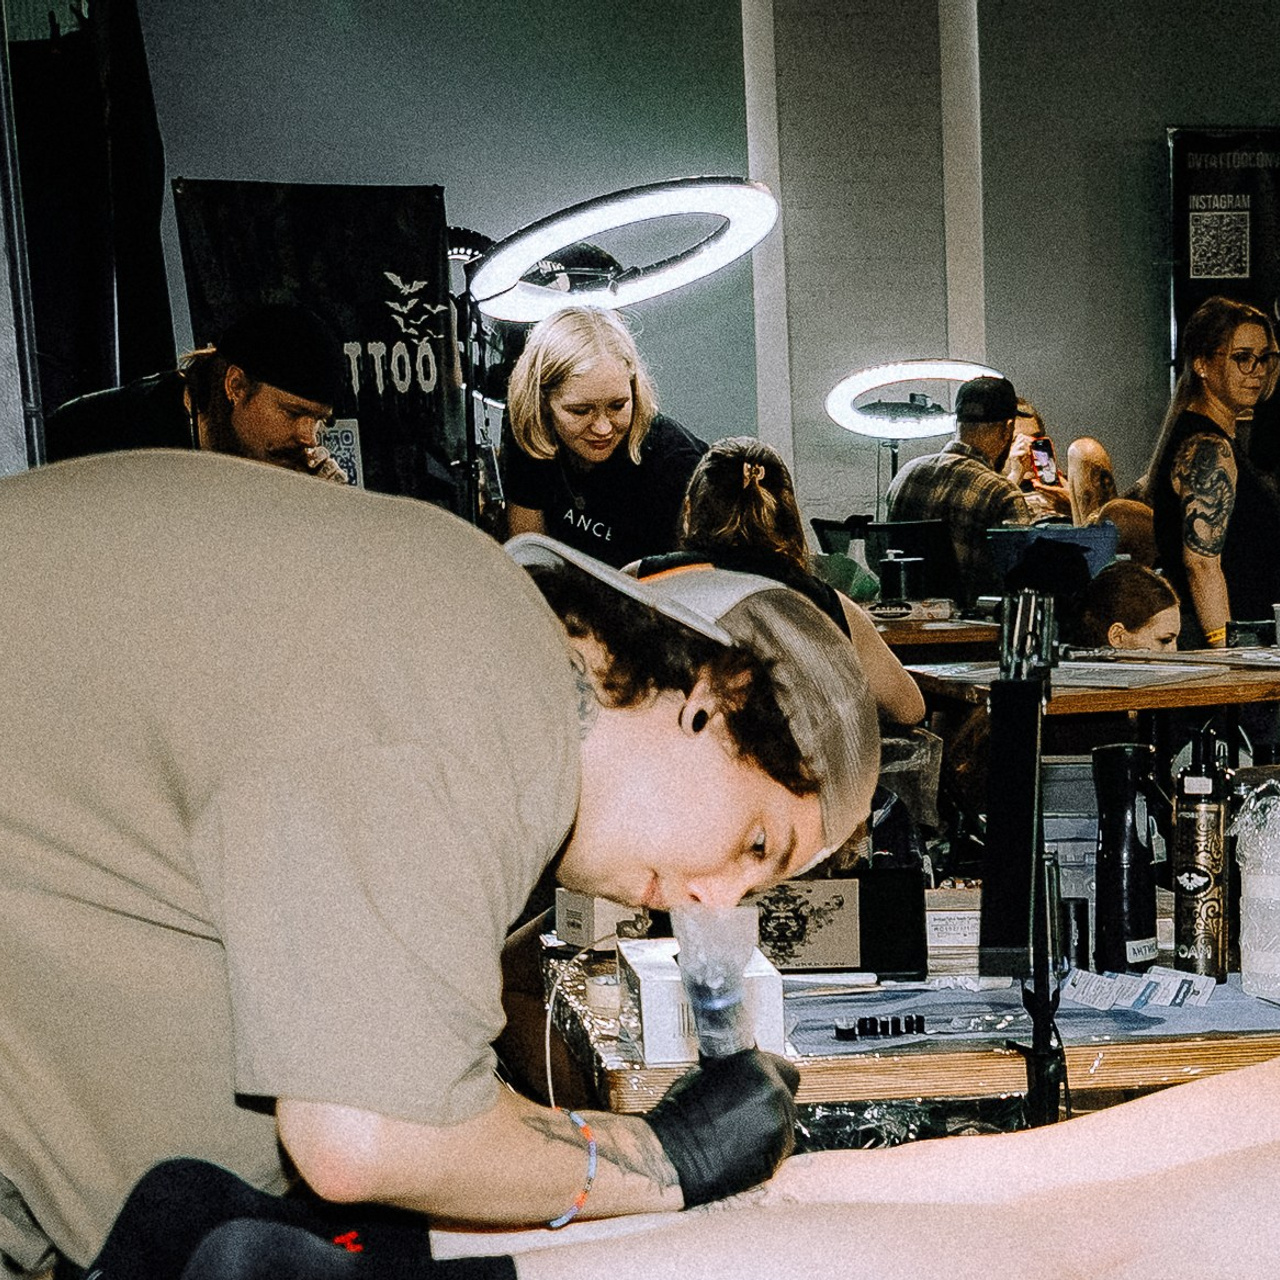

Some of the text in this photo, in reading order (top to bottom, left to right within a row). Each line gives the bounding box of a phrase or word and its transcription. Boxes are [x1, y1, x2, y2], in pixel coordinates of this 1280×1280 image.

[1189, 195, 1250, 209] INSTAGRAM
[344, 341, 437, 396] TTOO
[1178, 944, 1212, 960] OAM
